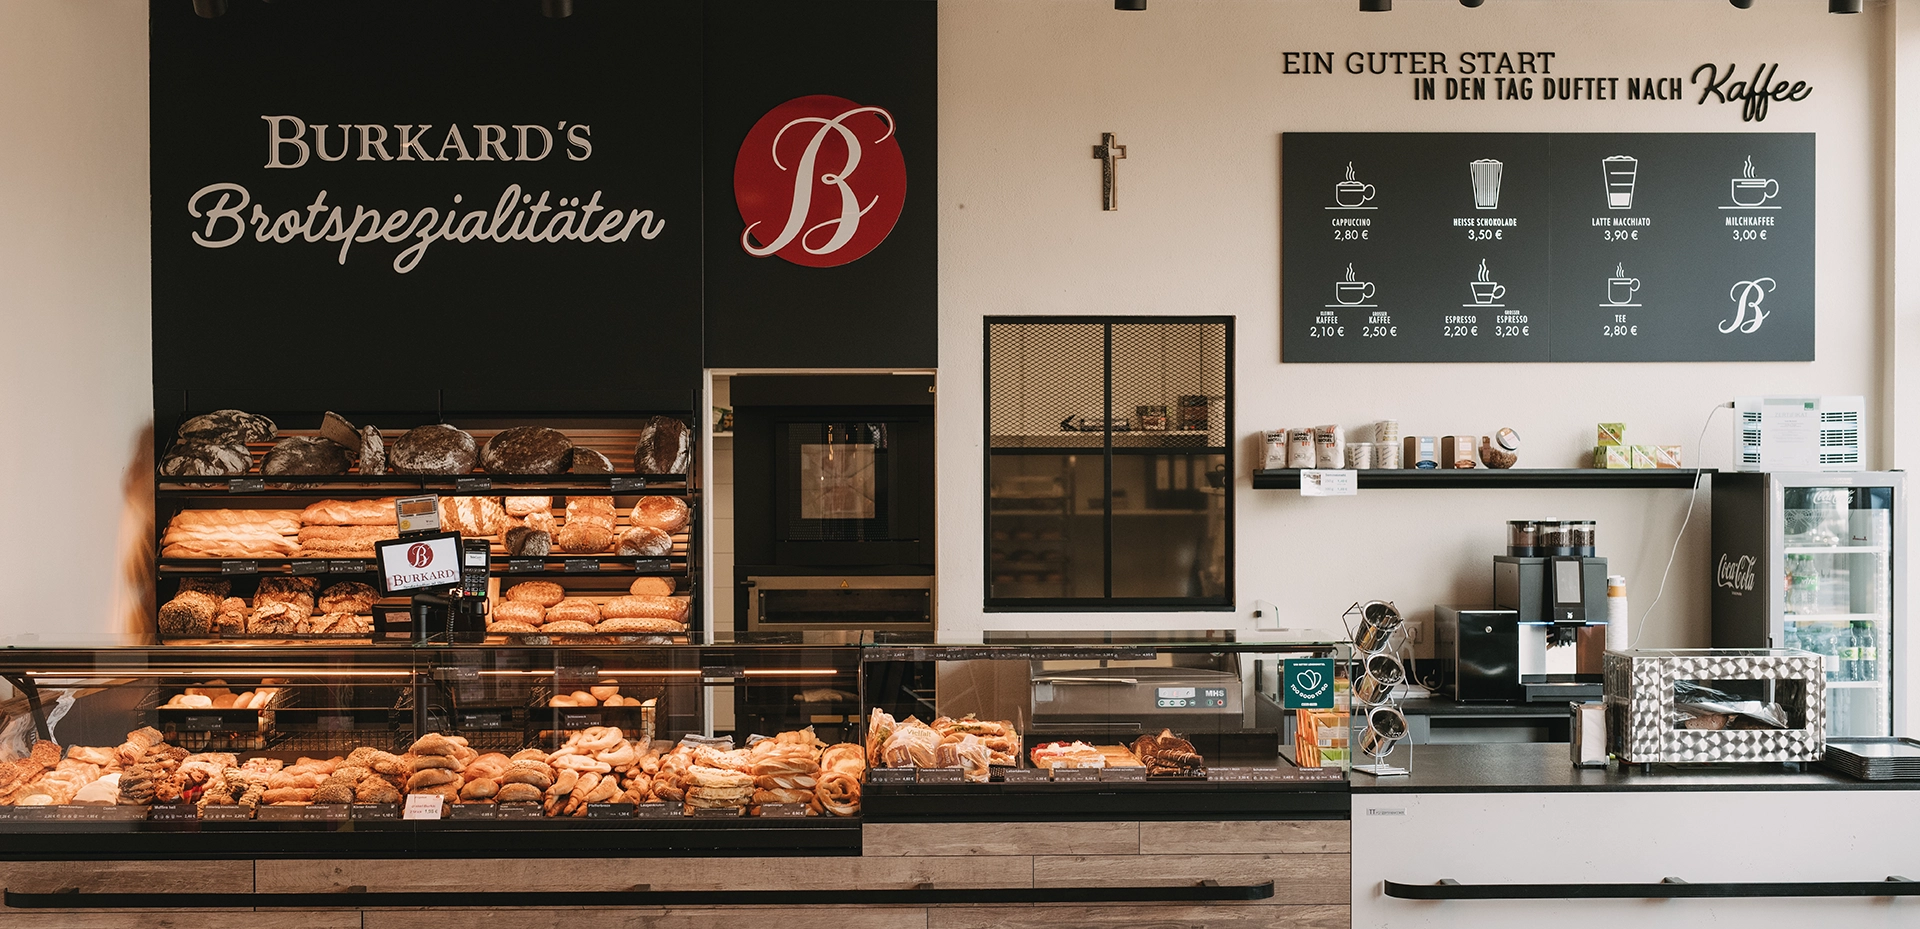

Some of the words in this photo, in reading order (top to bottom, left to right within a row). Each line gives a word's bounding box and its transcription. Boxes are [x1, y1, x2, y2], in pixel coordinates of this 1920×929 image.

[1281, 52, 1335, 74] EIN
[1345, 52, 1448, 74] GUTER
[1459, 52, 1556, 74] START
[1414, 78, 1434, 101] IN
[1446, 78, 1486, 101] DEN
[1495, 78, 1535, 101] TAG
[1543, 78, 1620, 101] DUFTET
[1628, 77, 1684, 101] NACH
[1690, 62, 1814, 122] Kaffee
[1331, 218, 1371, 227] CAPPUCCINO
[1453, 218, 1475, 227] HEISSE
[1476, 218, 1518, 227] SCHOKOLADE
[1591, 217, 1611, 227] LATTE
[1612, 217, 1651, 227] MACCHIATO
[1725, 216, 1775, 226] MILCHKAFFEE
[187, 182, 666, 274] Brotspezialitäten
[1334, 230, 1359, 241] 2,80
[1360, 230, 1369, 240] €
[1468, 229, 1493, 241] 3,50
[1495, 229, 1503, 240] €
[1604, 230, 1629, 242] 3,90
[1631, 230, 1639, 240] €
[1732, 229, 1757, 241] 3,00
[1759, 229, 1767, 240] €
[1315, 316, 1338, 325] KAFFEE
[1368, 316, 1391, 325] KAFFEE
[1445, 315, 1477, 324] ESPRESSO
[1496, 315, 1528, 324] ESPRESSO
[1614, 314, 1627, 323] TEE
[1310, 326, 1335, 338] 2,10
[1337, 326, 1345, 337] €
[1362, 326, 1388, 338] 2,50
[1390, 326, 1398, 337] €
[1443, 325, 1468, 338] 2,20
[1470, 325, 1479, 336] €
[1495, 325, 1520, 338] 3,20
[1522, 325, 1530, 336] €
[1603, 325, 1628, 337] 2,80
[1630, 325, 1638, 336] €
[393, 569, 455, 587] BURKARD
[1718, 553, 1757, 591] Coca-Cola
[1290, 684, 1300, 694] TOO
[1321, 683, 1328, 691] GO
[906, 729, 932, 738] Vielfalt
